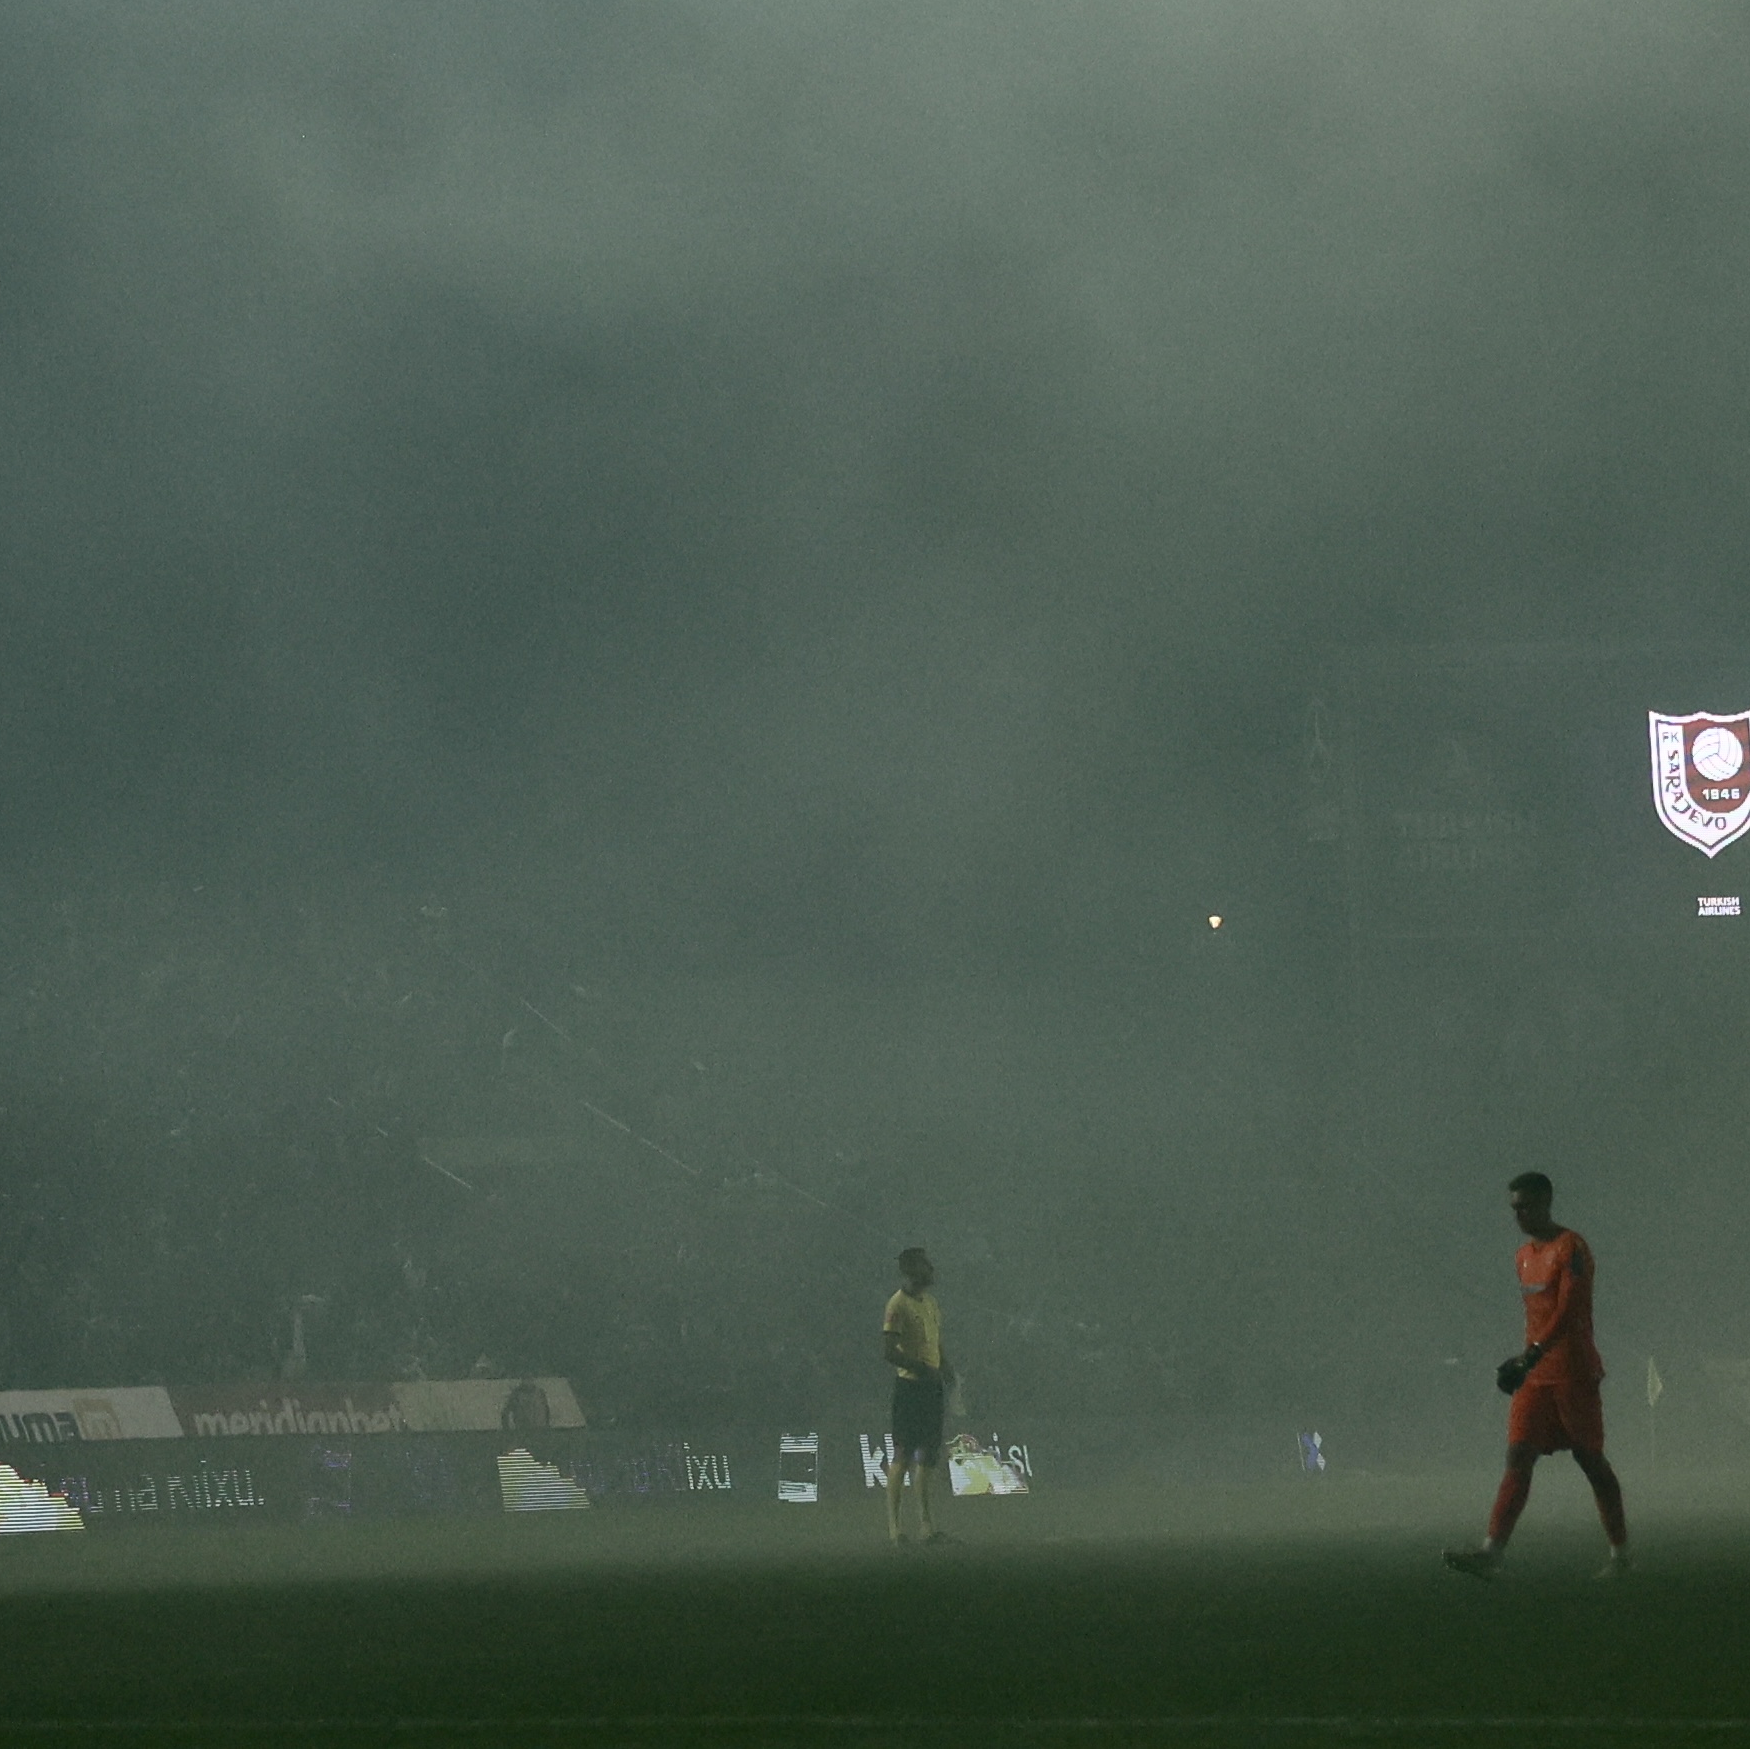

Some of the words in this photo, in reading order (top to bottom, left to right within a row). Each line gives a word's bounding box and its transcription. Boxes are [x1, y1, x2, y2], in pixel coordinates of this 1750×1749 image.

[1662, 731, 1679, 743] FK
[1665, 749, 1727, 830] SARAJEVO
[1697, 896, 1740, 907] TURKISH
[1697, 906, 1741, 917] AIRLINES
